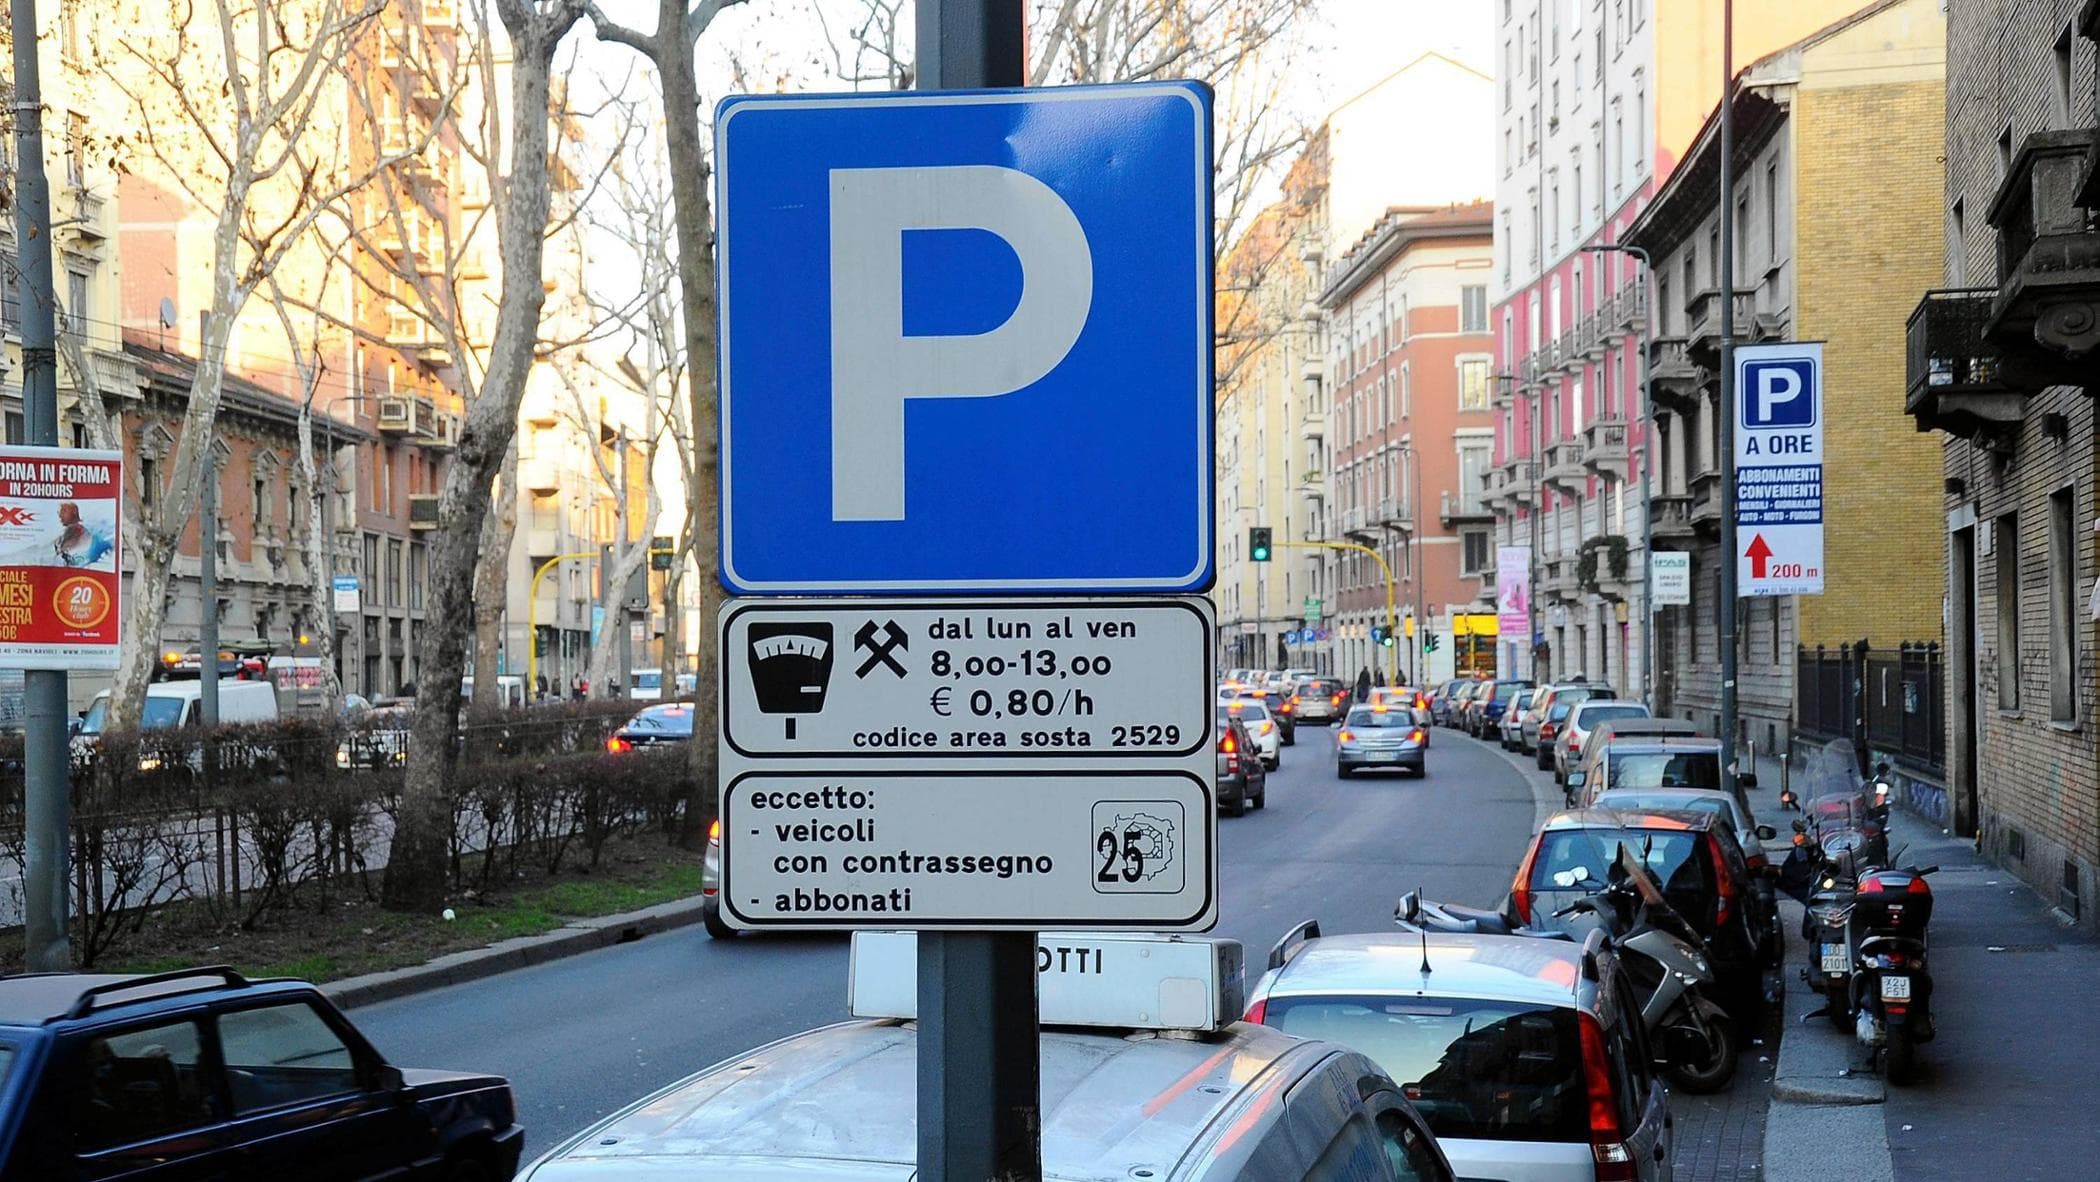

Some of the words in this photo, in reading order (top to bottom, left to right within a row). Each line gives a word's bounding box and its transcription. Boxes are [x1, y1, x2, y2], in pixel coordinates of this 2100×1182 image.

[830, 165, 1093, 521] P
[1758, 367, 1802, 422] P
[1746, 436, 1760, 455] A
[1769, 434, 1813, 454] ORE
[40, 463, 55, 482] IN
[59, 464, 111, 484] FORMA
[1738, 467, 1820, 484] ABBONAMENTI
[9, 482, 20, 496] IN
[23, 483, 73, 497] 20HOURS
[1738, 483, 1820, 499] CONVENIENTI
[1739, 511, 1759, 522] AUTO
[1763, 511, 1784, 521] MOTO
[1772, 564, 1802, 578] 200
[1807, 567, 1818, 577] m
[71, 586, 92, 604] 20
[929, 617, 973, 640] dal
[988, 616, 1031, 639] lun
[1046, 616, 1072, 639] al
[1087, 621, 1136, 638] ven
[930, 686, 952, 716] €
[970, 688, 1094, 719] 0,80/h
[853, 726, 938, 747] codice
[950, 731, 1007, 747] area
[1020, 726, 1092, 747] sosta
[1111, 724, 1180, 747] 2529
[751, 785, 875, 810] eccetto:
[775, 818, 875, 843] veicoli
[774, 855, 827, 874] con
[842, 849, 1053, 878] contrassegno
[1098, 831, 1144, 883] 25
[775, 887, 911, 912] abbonati
